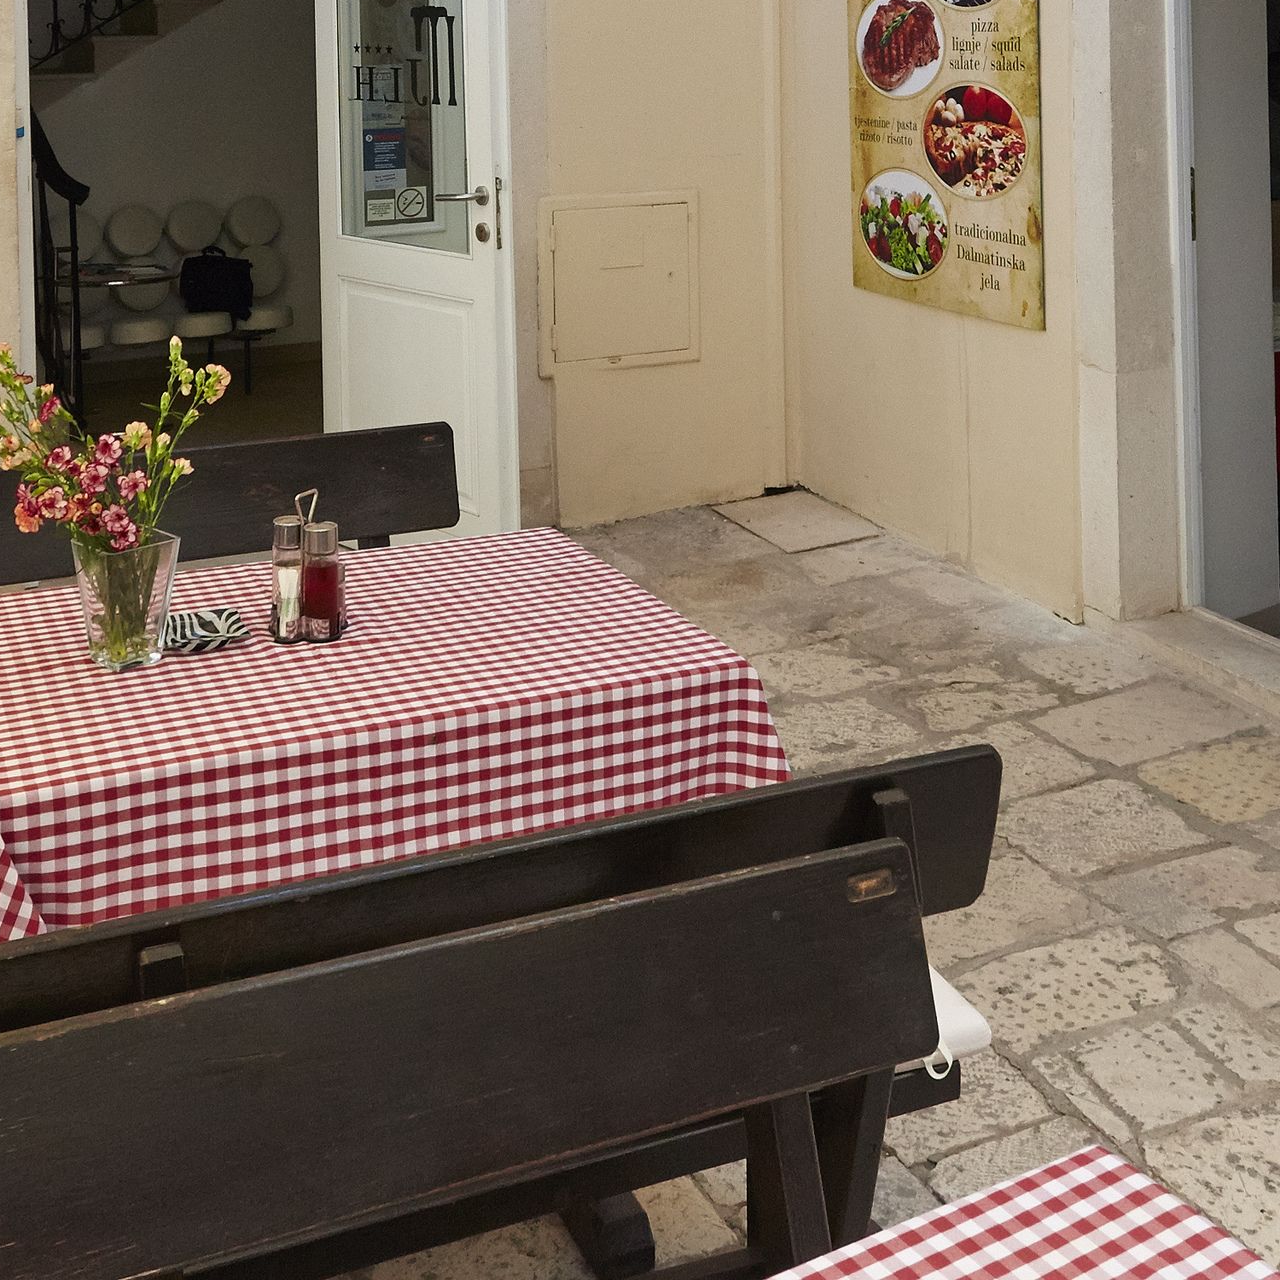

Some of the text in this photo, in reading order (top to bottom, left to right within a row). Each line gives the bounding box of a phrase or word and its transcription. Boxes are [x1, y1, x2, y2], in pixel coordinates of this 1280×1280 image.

[971, 17, 1000, 36] pizza
[952, 36, 981, 55] lignje
[991, 36, 1022, 56] squid
[949, 56, 981, 71] salate
[990, 55, 1026, 72] salads
[896, 120, 918, 132] pasta
[887, 132, 913, 146] risotto
[954, 221, 1027, 247] tradicionalna
[956, 244, 1026, 271] Dalmatinska
[979, 272, 1001, 291] jela
